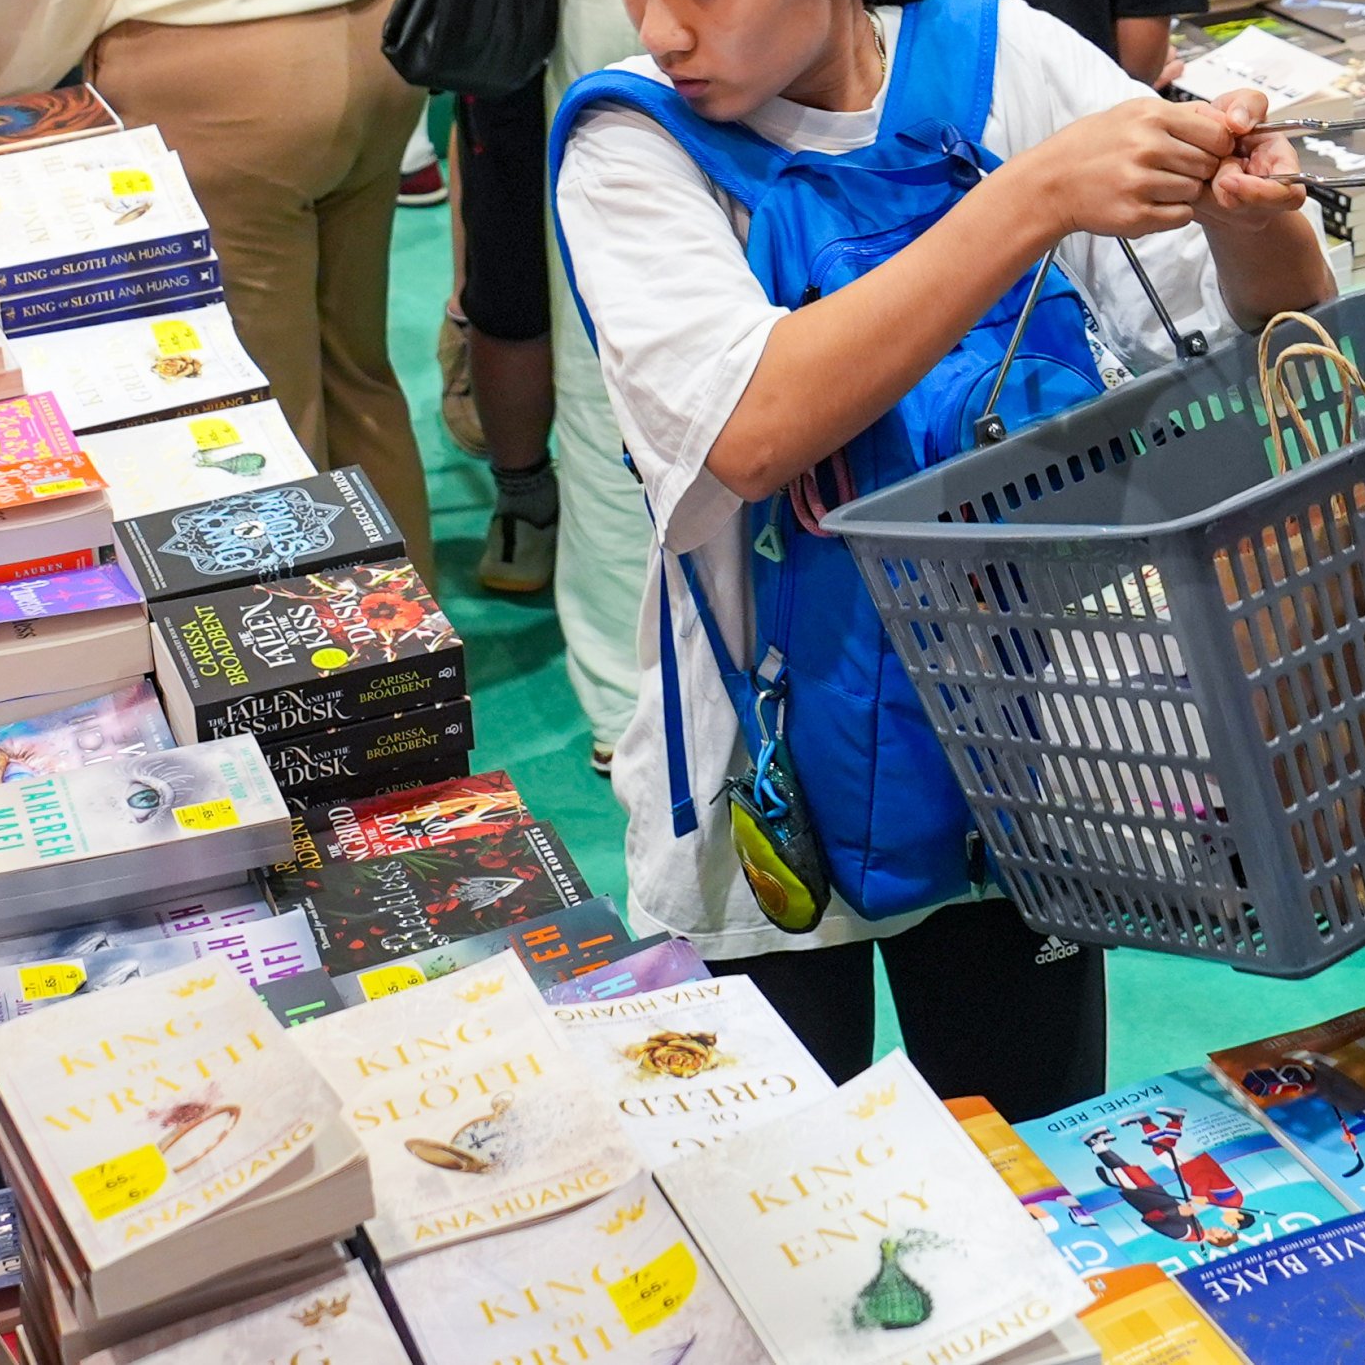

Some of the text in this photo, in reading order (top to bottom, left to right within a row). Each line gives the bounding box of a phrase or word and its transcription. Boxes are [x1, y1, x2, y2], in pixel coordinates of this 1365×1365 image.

[14, 243, 182, 284] KING SLOTH ANA HUANG
[22, 275, 190, 317] KING SLOTH ANA HUANG
[256, 492, 311, 554] STORM
[330, 470, 383, 543] REBECCA YARROS
[15, 562, 63, 578] LAUREN
[240, 593, 296, 669] FALLEN
[289, 605, 334, 649] KISS
[327, 584, 378, 644] DUSK
[183, 620, 219, 677] CARISSA
[195, 606, 249, 685] BROADBENT
[359, 678, 432, 703] BROADBENT
[370, 671, 420, 690] CARISSA
[227, 691, 306, 723] FALLEN
[307, 694, 324, 704] AND
[326, 690, 344, 700] THE
[280, 699, 352, 729] DUSK
[367, 734, 439, 759] BROADBENT
[377, 727, 426, 746] CARISSA
[287, 757, 359, 786] DUSK
[20, 779, 75, 858] TAHEREH
[530, 827, 562, 874] ROBERTS
[1035, 941, 1080, 965] adidas
[554, 984, 721, 1022] ANA HUANG
[59, 1012, 203, 1076] KING
[355, 1017, 492, 1079] KING
[45, 1031, 264, 1131] WRATH
[353, 1053, 544, 1131] SLOTH
[421, 1065, 453, 1082] OF
[618, 1074, 797, 1117] GREED
[1048, 1084, 1163, 1133] RACHEL REID
[123, 1123, 314, 1242] ANA HUANG
[749, 1134, 895, 1215] KING
[414, 1168, 610, 1241] ANA HUANG
[780, 1179, 931, 1269] ENVY
[479, 1253, 630, 1326] KING
[1205, 1255, 1308, 1303] BLAKE
[926, 1299, 1052, 1365] HUANG
